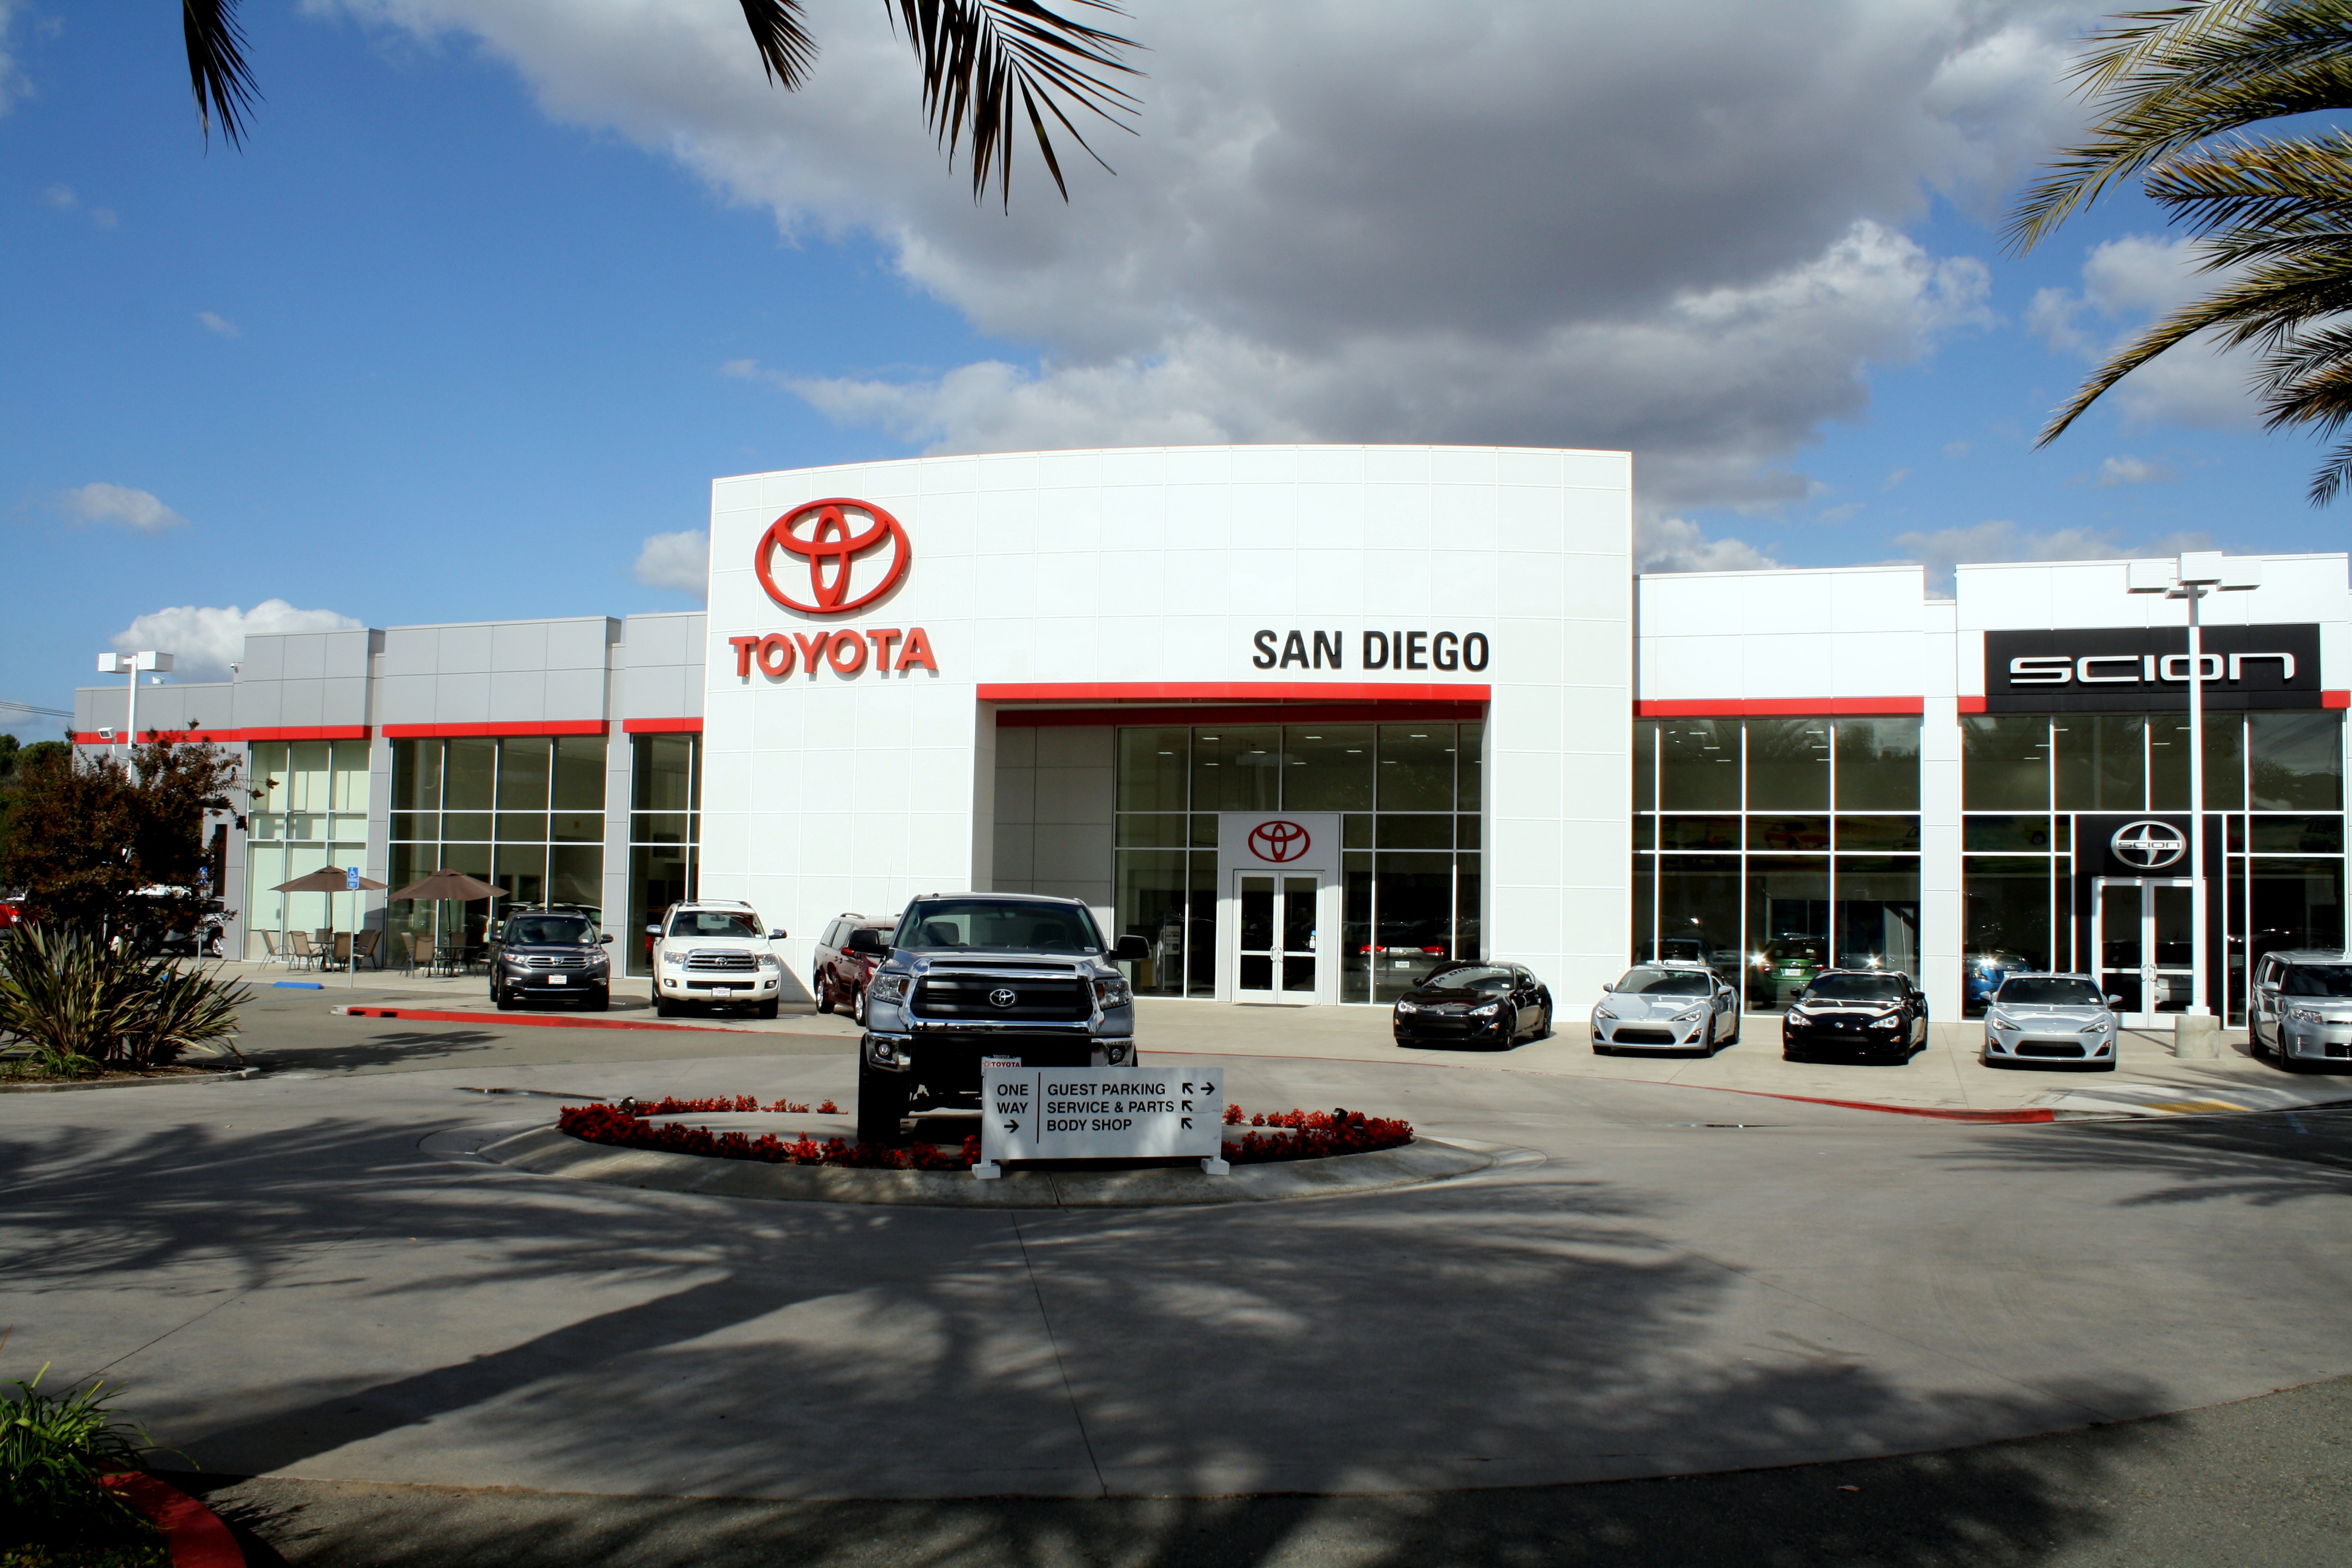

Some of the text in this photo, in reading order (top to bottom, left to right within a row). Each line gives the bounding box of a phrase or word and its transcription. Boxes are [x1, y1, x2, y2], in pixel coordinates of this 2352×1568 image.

[729, 628, 938, 677] TOYOTA
[1253, 630, 1489, 671] SAN DIEGO
[997, 1083, 1029, 1096] ONE
[1047, 1083, 1166, 1096] GUEST PARKING
[997, 1102, 1029, 1114] WAY
[1047, 1100, 1174, 1114] SERVICE & PARTS
[1047, 1119, 1132, 1132] BODY SHOP
